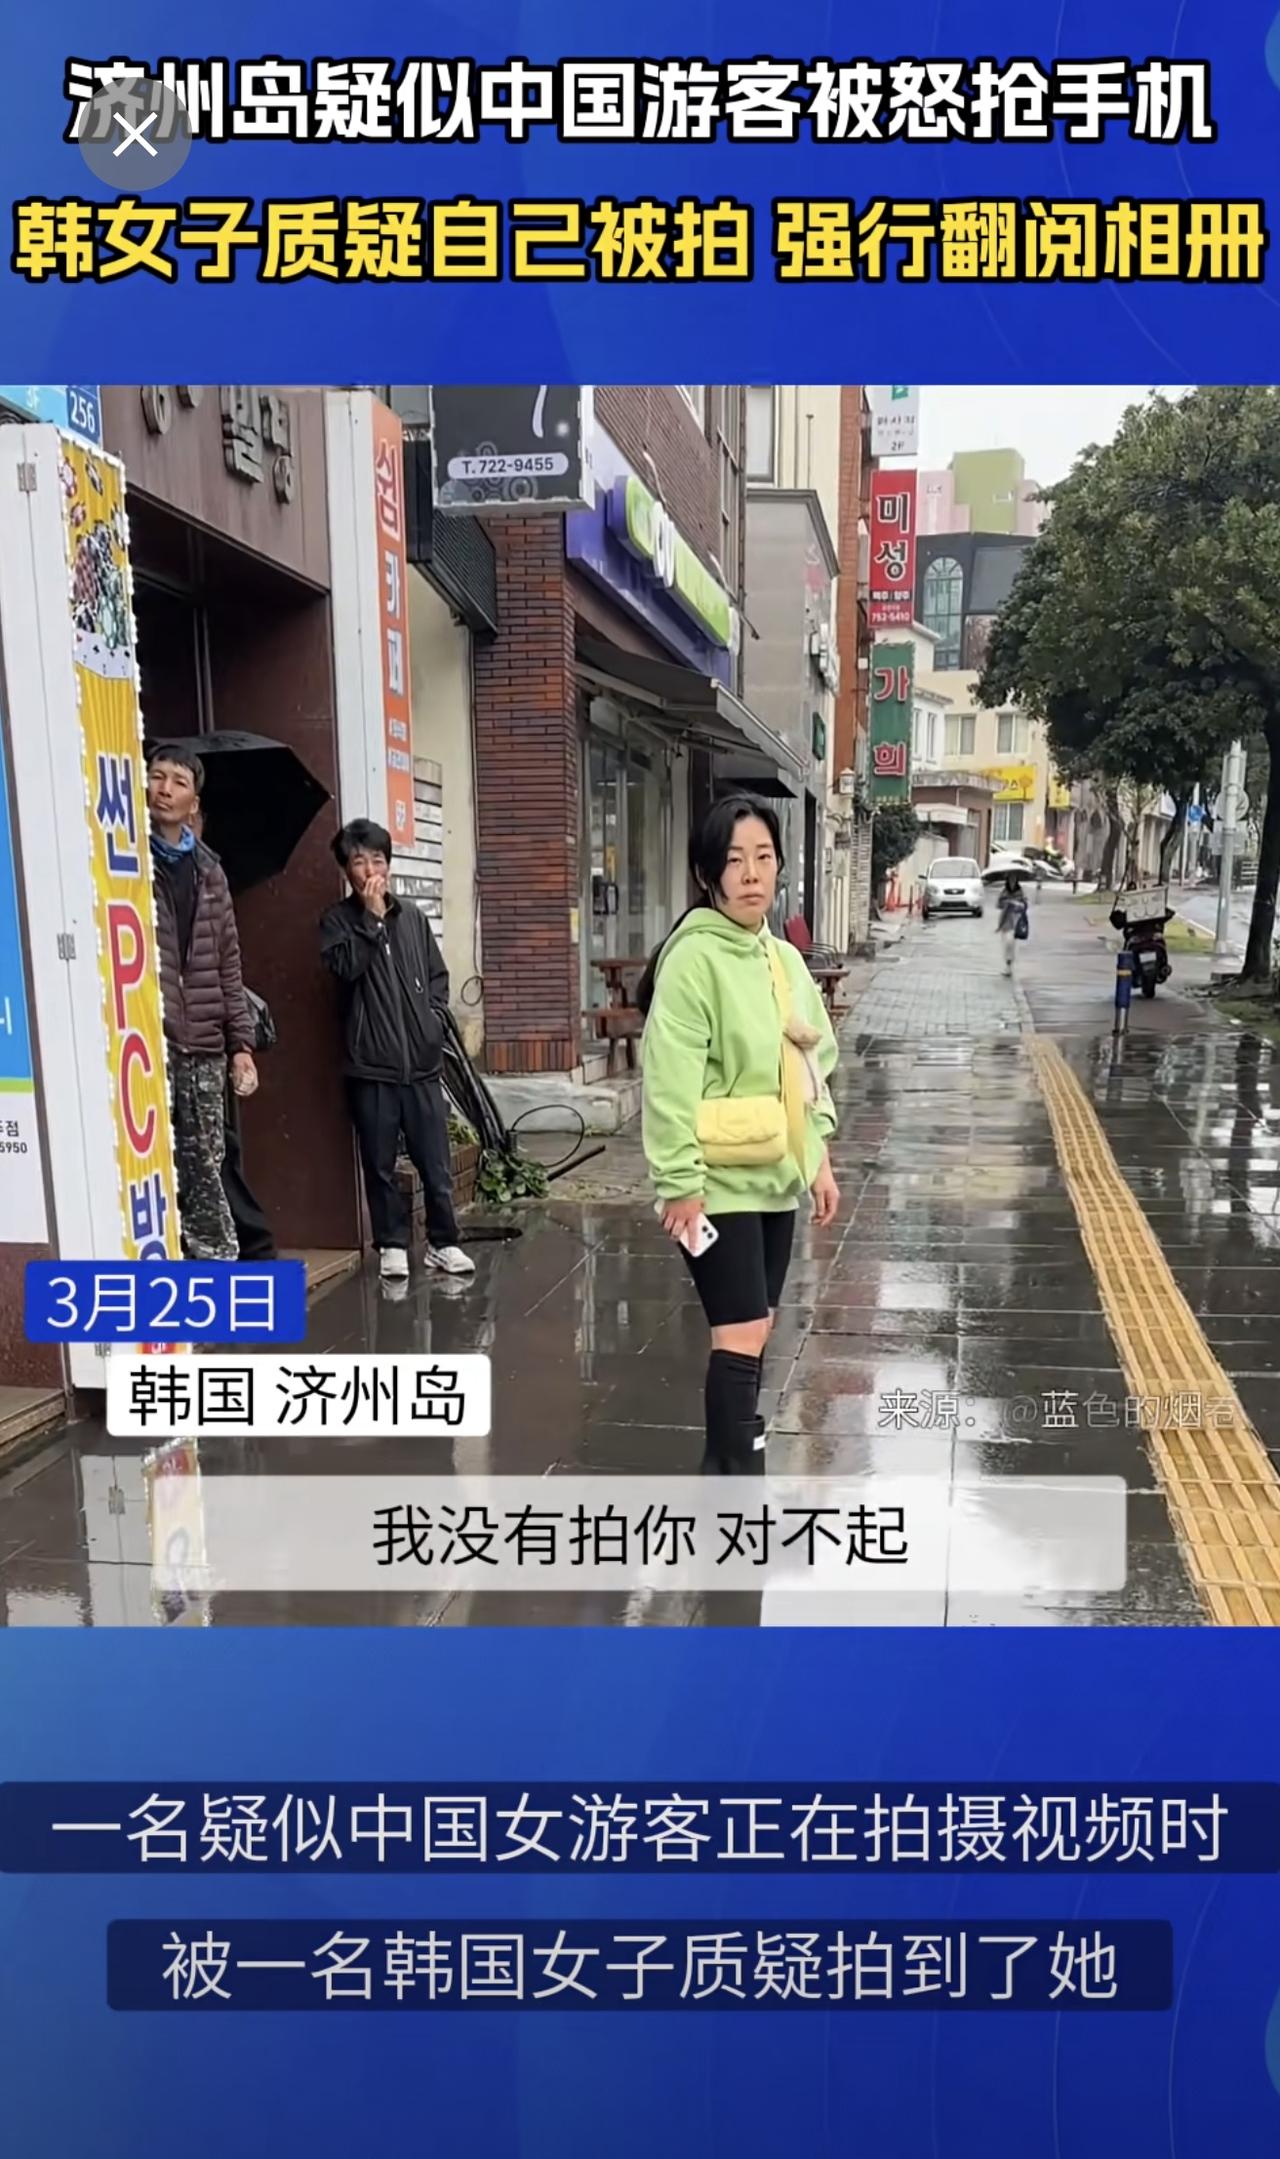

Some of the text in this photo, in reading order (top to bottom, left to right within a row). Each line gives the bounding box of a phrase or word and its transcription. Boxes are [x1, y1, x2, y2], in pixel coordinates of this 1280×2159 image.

[68, 391, 96, 434] 256
[874, 491, 911, 582] 미성
[874, 665, 911, 777] 가희
